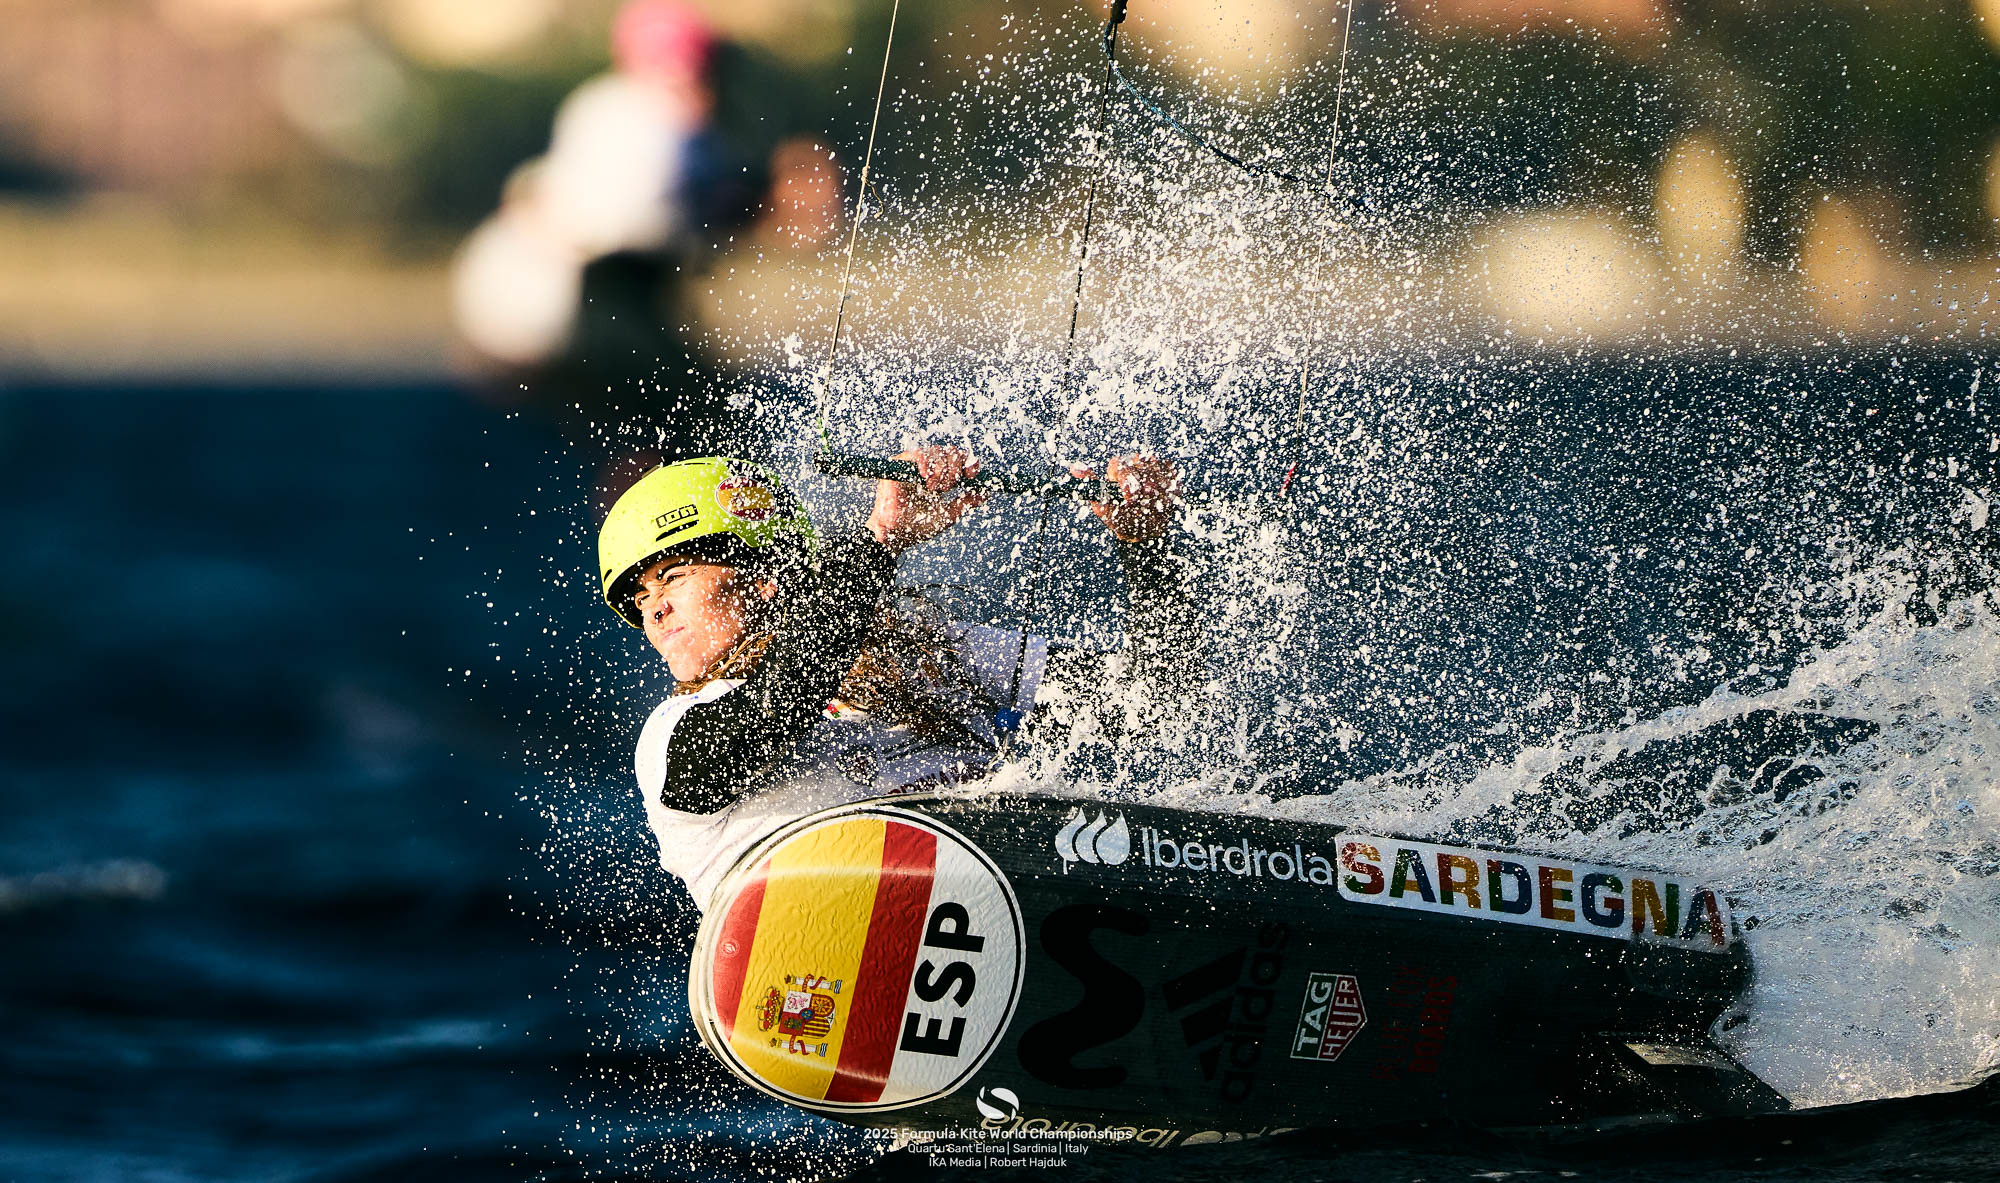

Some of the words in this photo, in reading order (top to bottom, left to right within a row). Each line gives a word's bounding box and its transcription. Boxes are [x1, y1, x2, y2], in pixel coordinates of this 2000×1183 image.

[1141, 827, 1333, 886] Iberdrola
[1341, 842, 1726, 946] SARDEGNA
[900, 902, 985, 1058] ESP
[1222, 921, 1291, 1103] adidas
[1296, 979, 1333, 1052] TAG
[1322, 979, 1363, 1057] HEUER
[1408, 976, 1457, 1072] BOARDS
